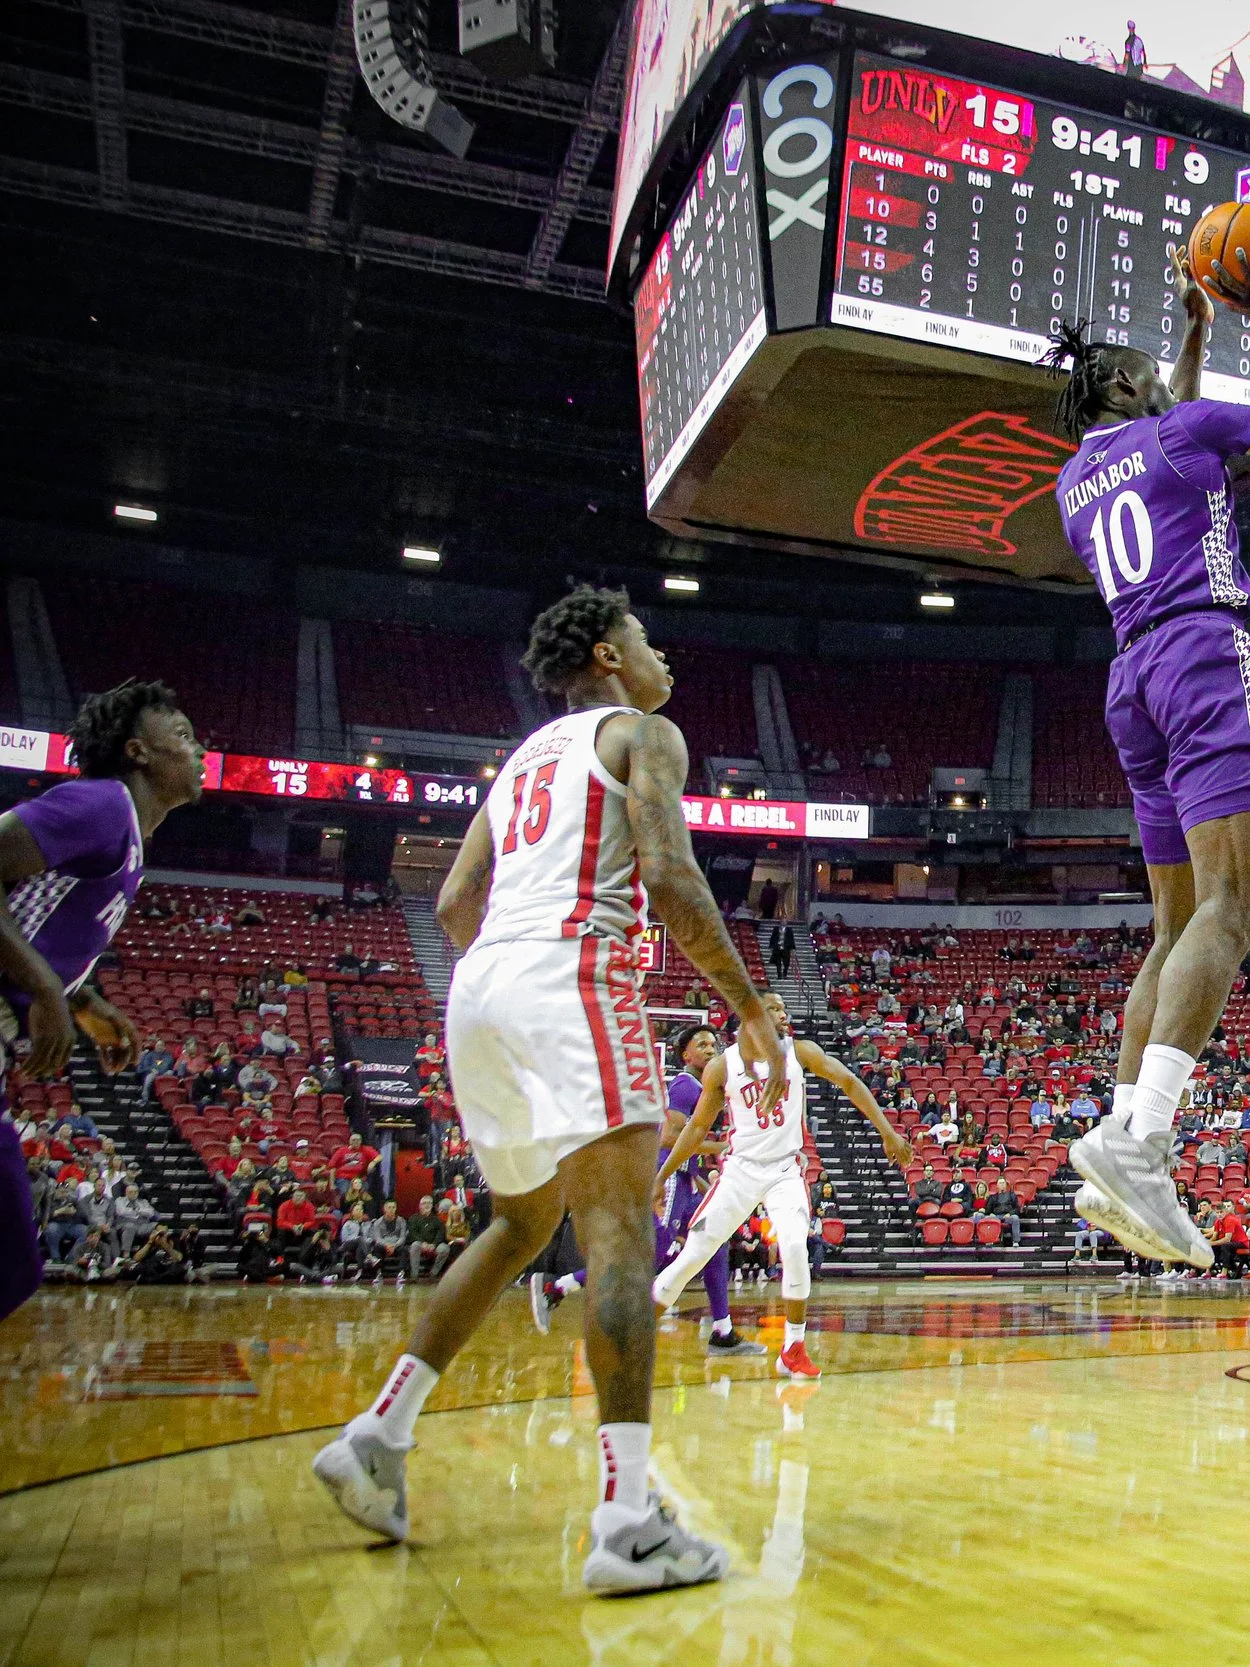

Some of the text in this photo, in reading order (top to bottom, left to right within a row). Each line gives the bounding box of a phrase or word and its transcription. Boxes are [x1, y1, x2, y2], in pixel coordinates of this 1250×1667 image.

[861, 71, 960, 134] UNLV
[966, 94, 1020, 135] 15
[762, 63, 834, 242] COX
[962, 143, 1017, 175] FLS 2
[1051, 116, 1142, 169] 9:41
[707, 153, 716, 189] 9
[859, 145, 1074, 209] PLAYER PTS RBS AST FLS
[1070, 170, 1120, 199] 1ST
[1183, 152, 1210, 185] 9
[673, 185, 698, 252] 9:41
[876, 174, 1068, 235] 1 0 0 0 0
[1103, 203, 1183, 236] PLAYER PTS
[1165, 194, 1191, 216] FLS
[866, 197, 1067, 260] 10 3 1 1 0
[1118, 230, 1130, 249] 5
[655, 242, 669, 285] 15
[681, 240, 695, 276] 1ST
[863, 224, 1065, 286] 12 4 3 0 0
[1111, 254, 1134, 274] 10
[861, 249, 1064, 311] 15 6 5 0 0
[1111, 280, 1131, 300] 11
[1163, 292, 1175, 311] 2
[838, 303, 874, 321] FINDLAY
[858, 275, 1062, 336] 55 2 1 1 0
[1108, 303, 1131, 323] 15
[1161, 316, 1173, 335] 0
[925, 321, 960, 339] FINDLAY
[1010, 338, 1043, 356] FINDLAY
[1105, 328, 1129, 347] 55
[1160, 341, 1172, 360] 2
[1239, 358, 1250, 376] 0
[1065, 451, 1147, 518] IZUNABOR
[1090, 490, 1154, 605] 10
[268, 760, 308, 774] UNLV
[271, 772, 308, 795] 15
[356, 773, 372, 790] 4
[395, 778, 408, 792] 2
[424, 782, 478, 805] 9:41
[502, 760, 559, 855] 15
[707, 803, 725, 826] A
[731, 804, 796, 830] REBEL.
[815, 809, 860, 823] FINDLAY
[995, 910, 1022, 926] 102
